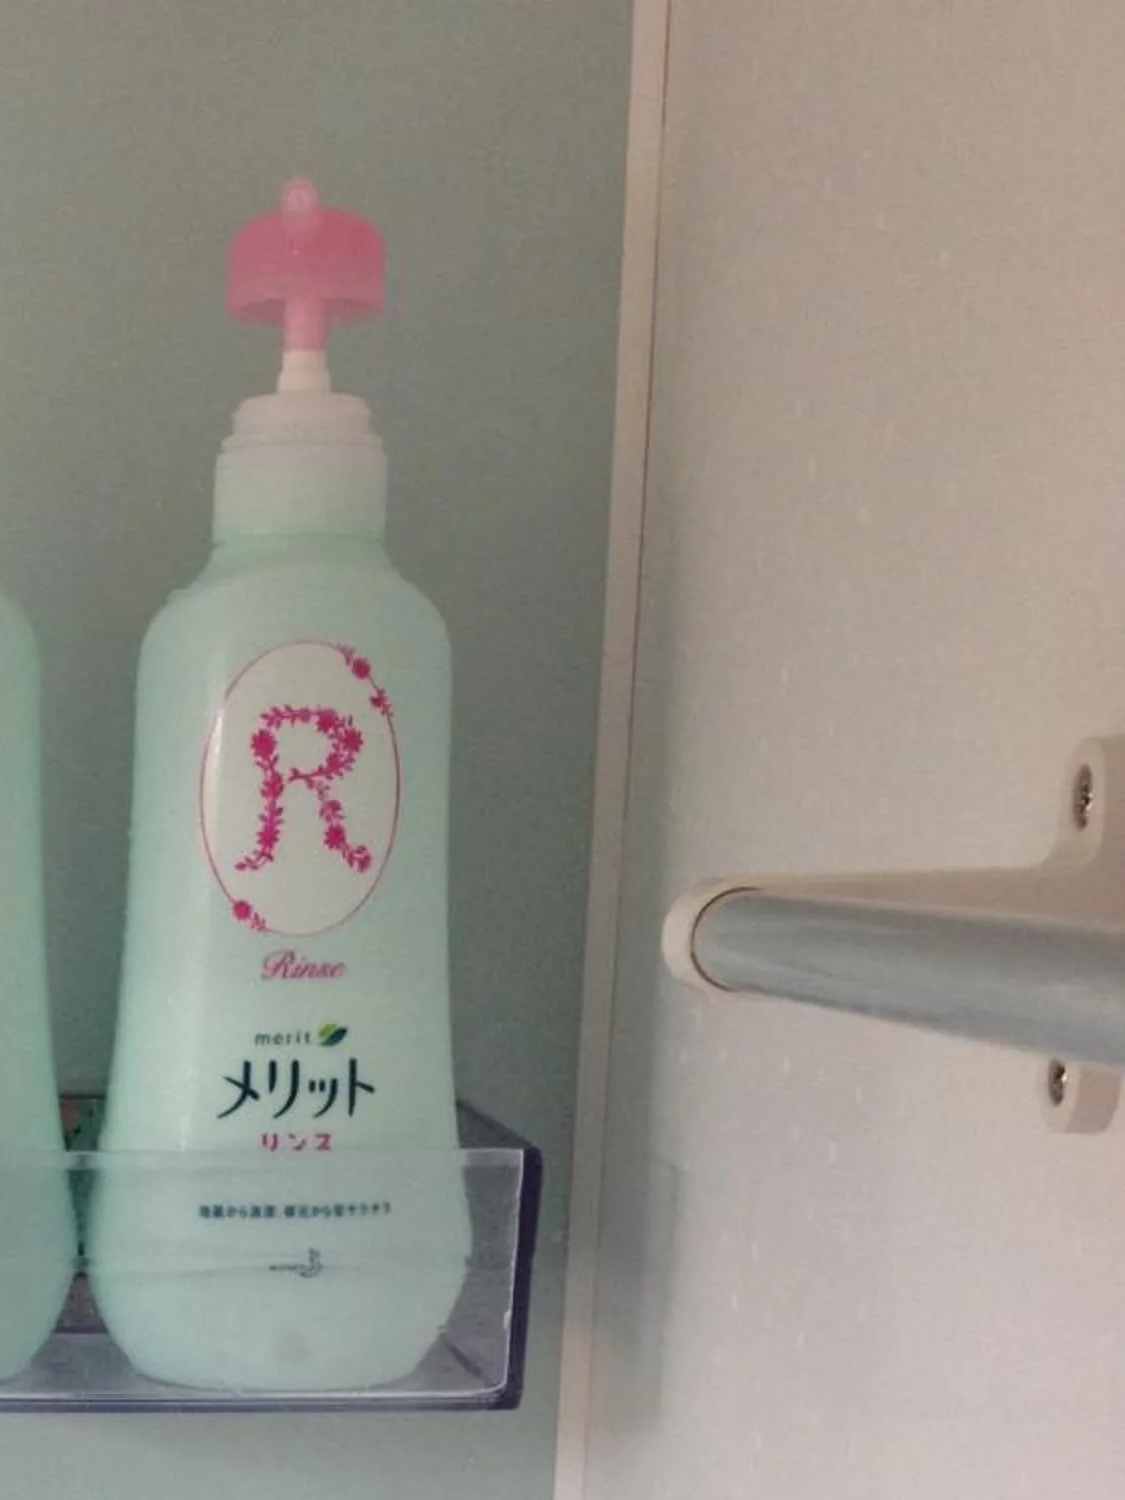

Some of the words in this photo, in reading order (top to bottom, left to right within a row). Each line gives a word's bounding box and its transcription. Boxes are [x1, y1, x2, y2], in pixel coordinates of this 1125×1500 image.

[234, 704, 372, 873] R
[259, 949, 347, 981] Rinse
[254, 1029, 312, 1046] merit
[216, 1057, 376, 1119] メリット
[260, 1132, 333, 1152] リンス
